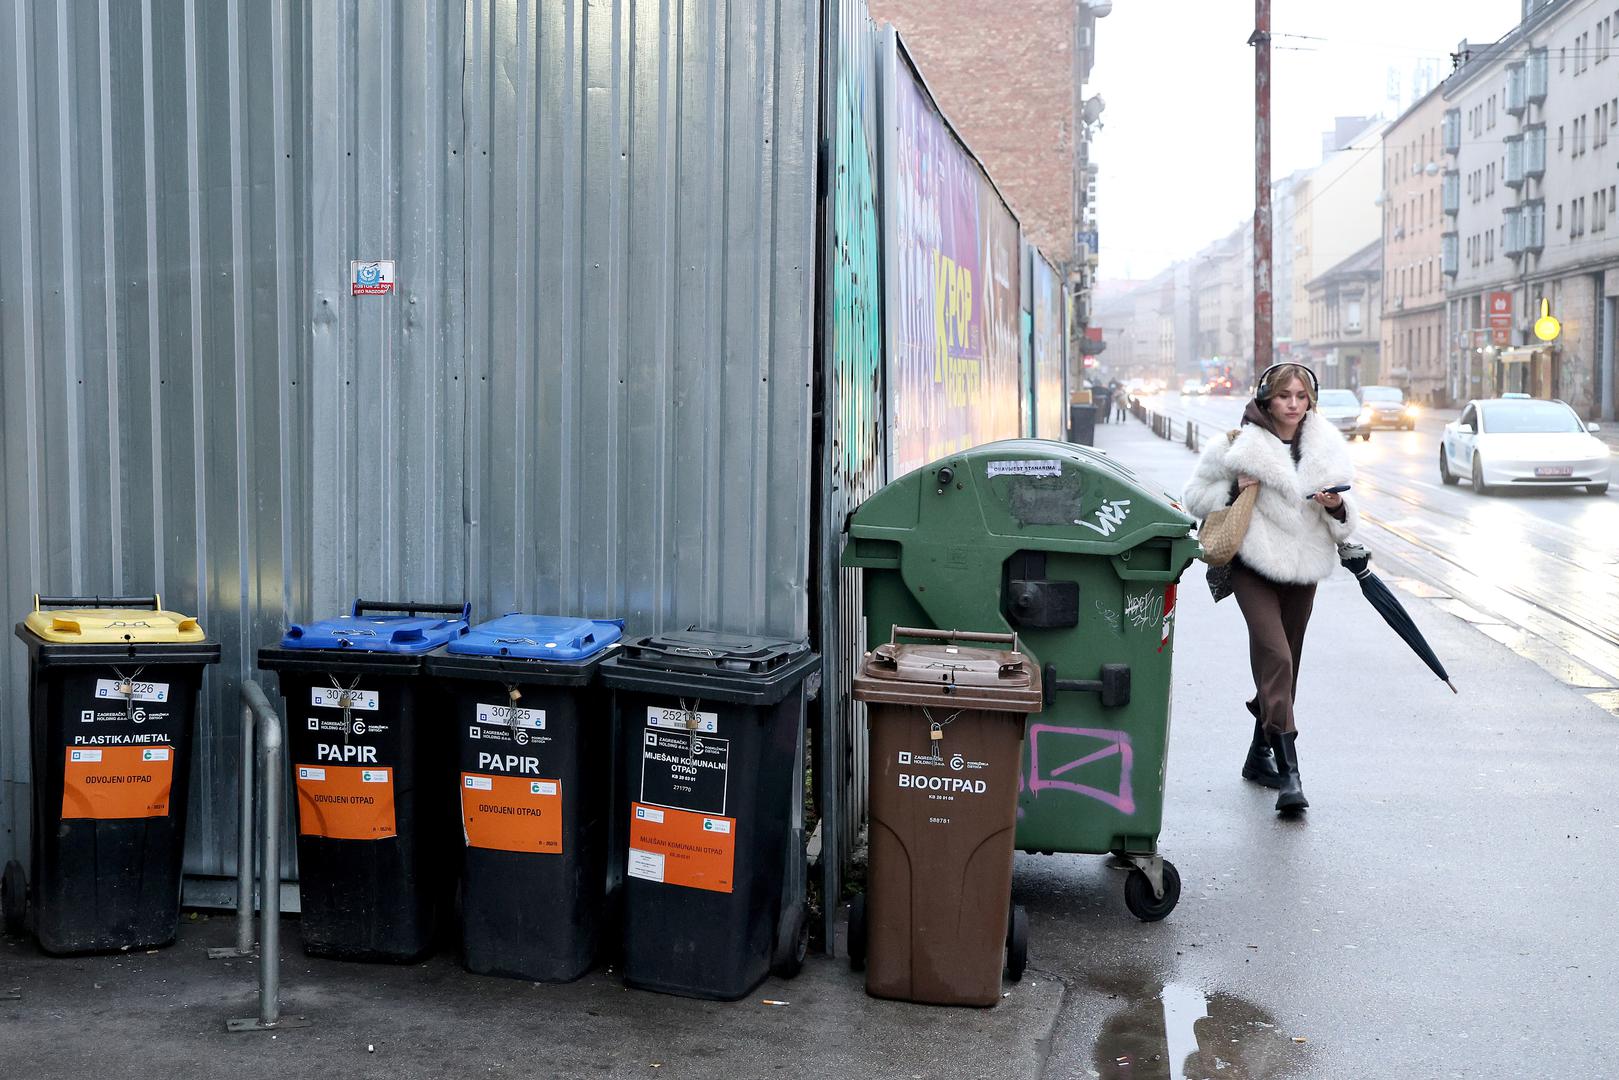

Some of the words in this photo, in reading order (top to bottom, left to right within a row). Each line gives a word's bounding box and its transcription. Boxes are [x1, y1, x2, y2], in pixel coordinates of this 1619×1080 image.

[113, 682, 154, 694] 3226
[326, 689, 363, 701] 3024
[74, 734, 171, 744] PLASTIKA/METAL
[317, 744, 378, 763] PAPIR
[479, 752, 540, 774] PAPIR
[644, 751, 679, 764] MIJEŠANI
[680, 757, 726, 770] KOMUNALNI
[671, 764, 697, 775] OTPAD
[85, 776, 125, 784] ODVOJENI
[127, 775, 152, 783] OTPAD
[898, 774, 987, 794] BIOOTPAD
[314, 794, 349, 804] ODVOJENI
[350, 795, 374, 804] OTPAD
[479, 804, 515, 815] ODVOJENI
[517, 807, 541, 817] OTPAD
